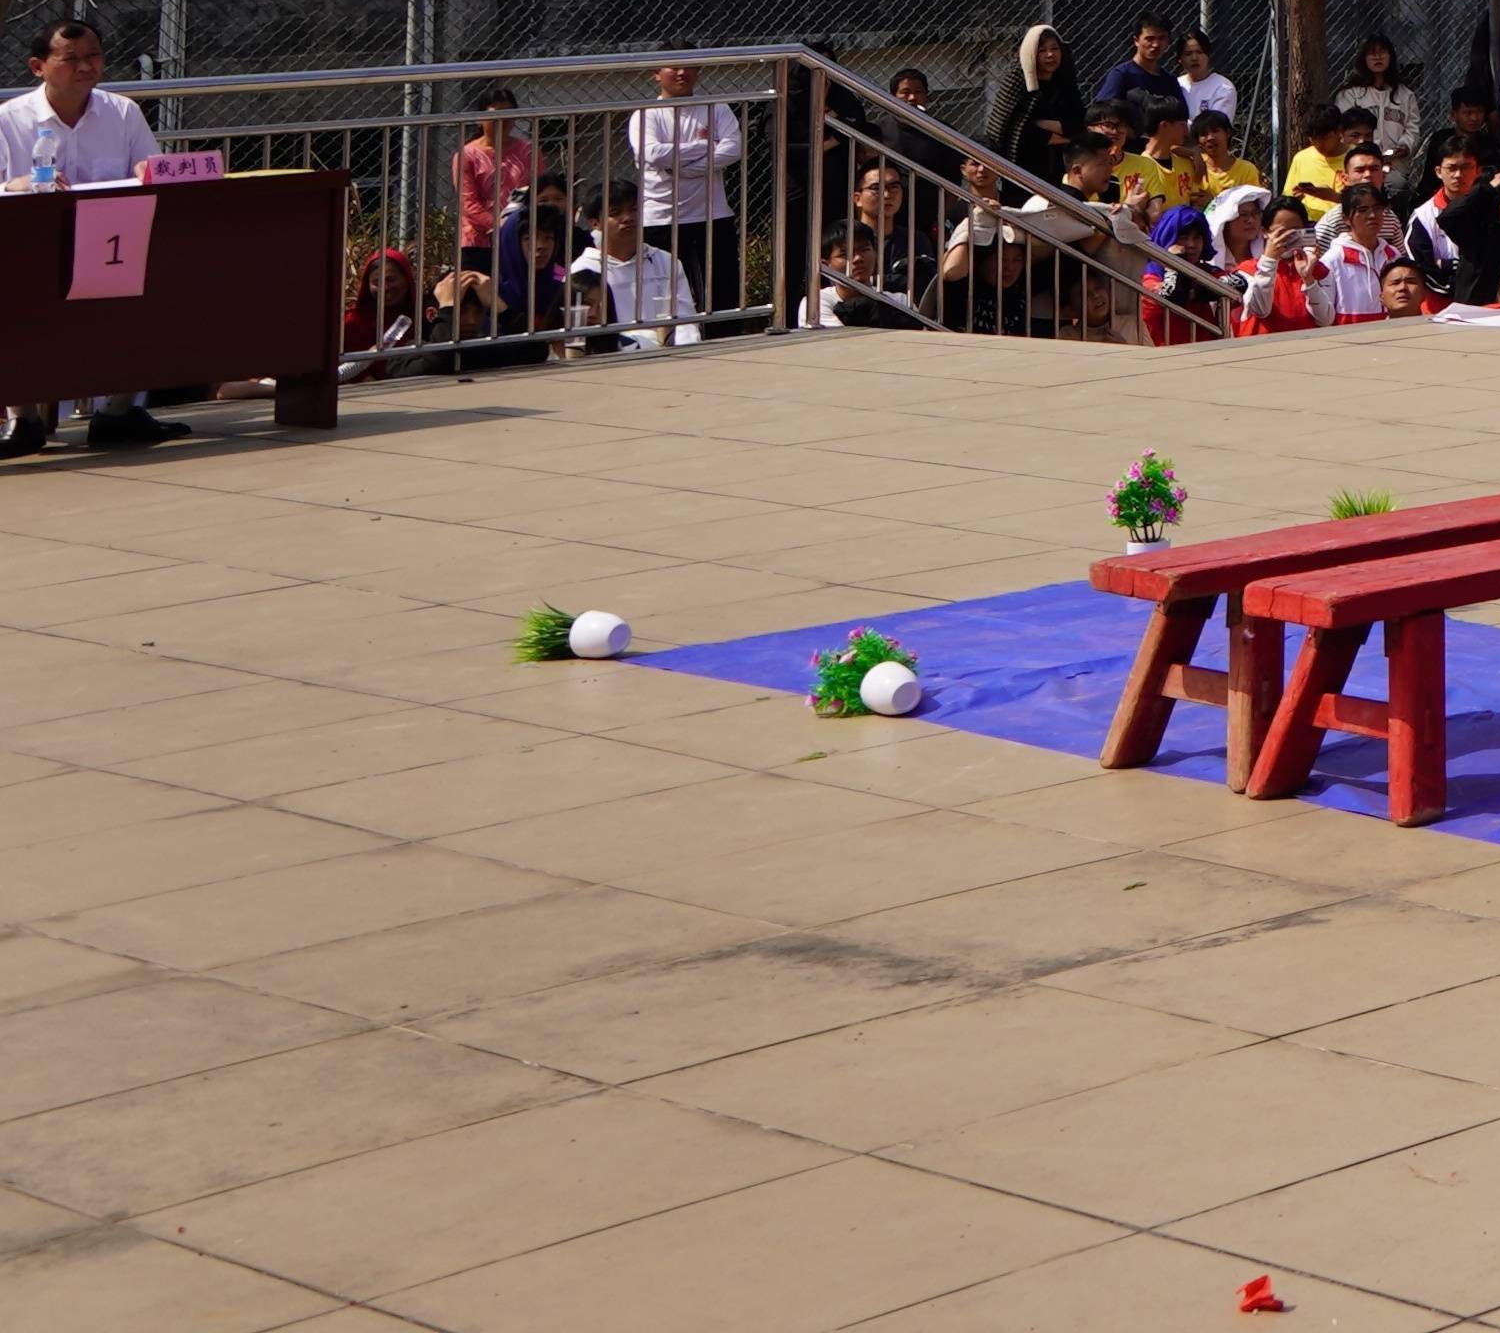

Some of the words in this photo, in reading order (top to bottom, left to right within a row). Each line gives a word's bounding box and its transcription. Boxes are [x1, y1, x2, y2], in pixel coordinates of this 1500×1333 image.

[154, 156, 219, 177] 裁判员
[104, 234, 124, 266] 1
